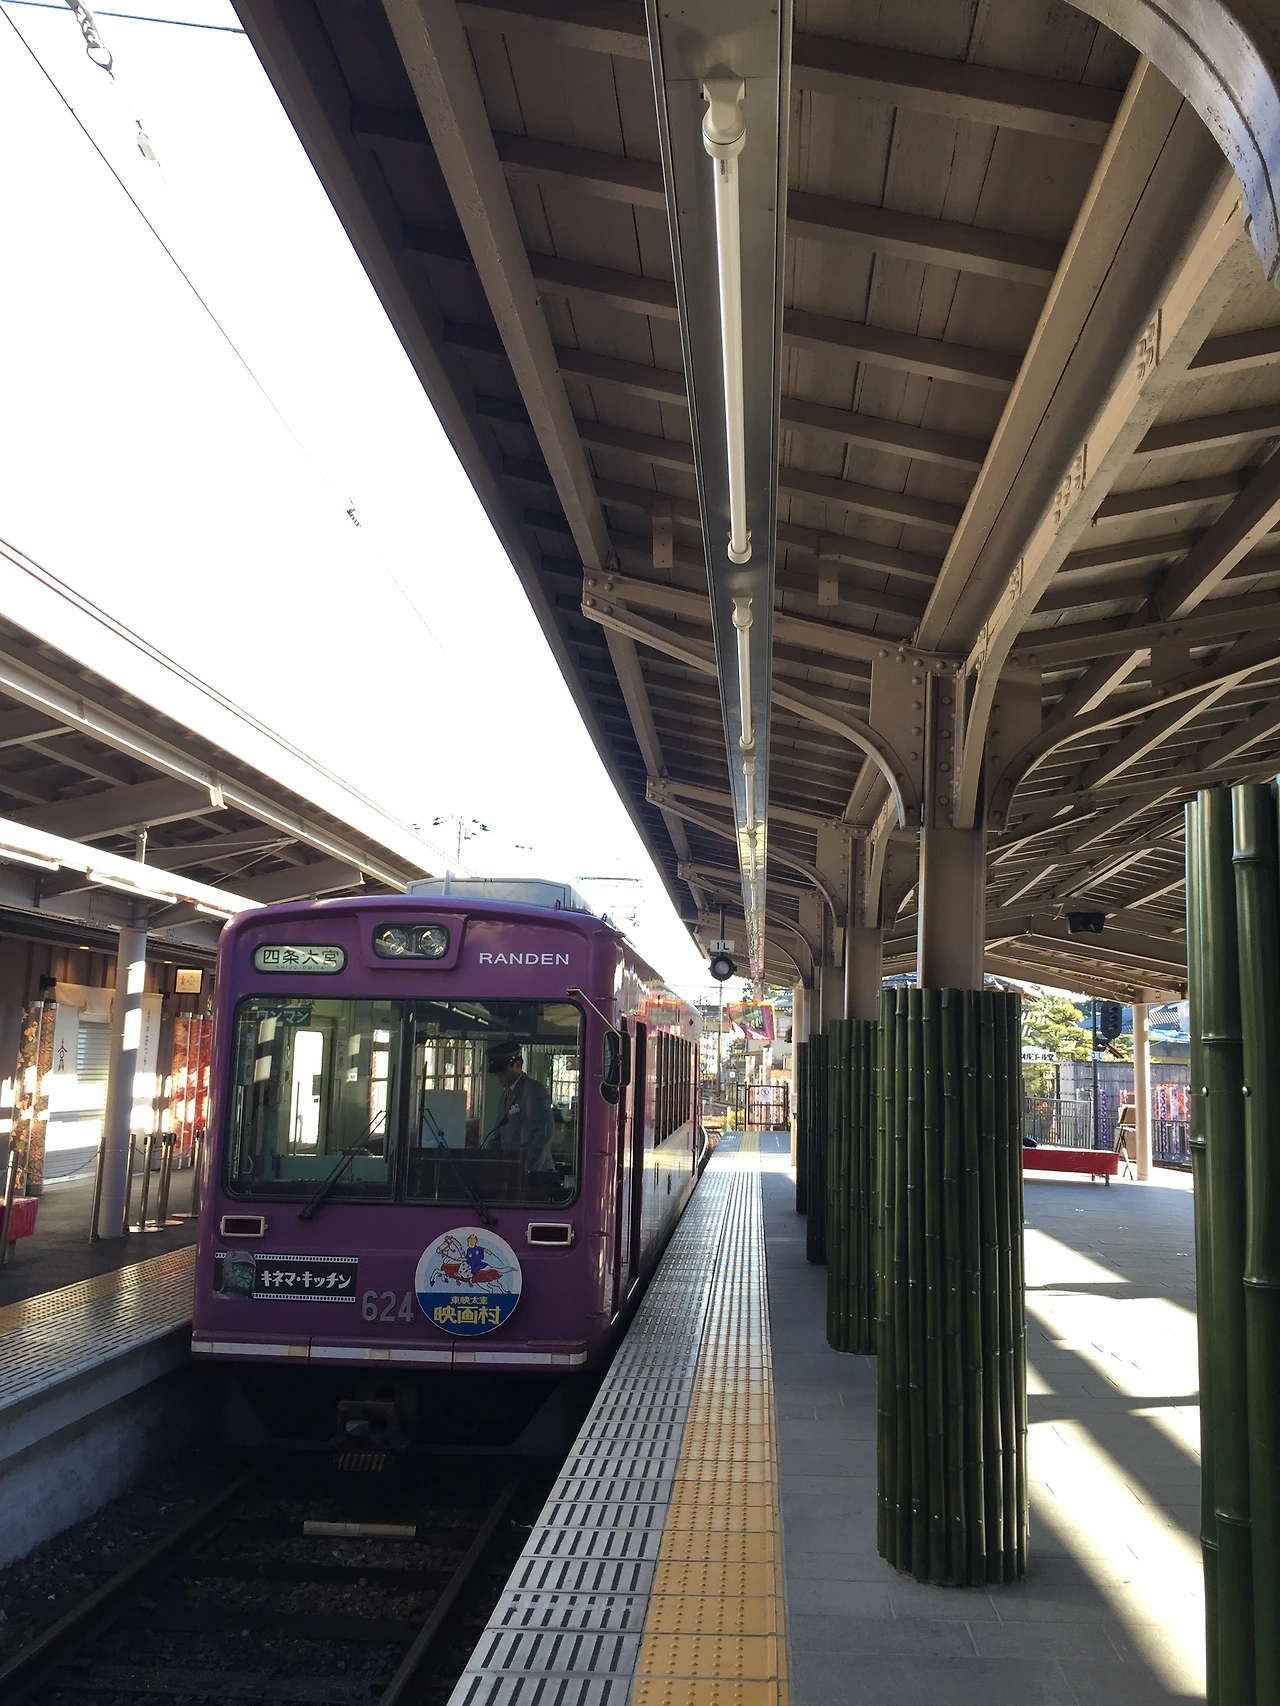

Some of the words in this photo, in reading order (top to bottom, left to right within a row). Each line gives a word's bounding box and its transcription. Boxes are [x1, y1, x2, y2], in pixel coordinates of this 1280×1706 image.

[263, 949, 339, 966] 四条大宮
[479, 952, 569, 965] RANDEN
[256, 1010, 310, 1024] ワンマン
[260, 1270, 352, 1289] キネマ・キッチン
[361, 1290, 414, 1322] 624
[433, 1305, 502, 1325] 映画村
